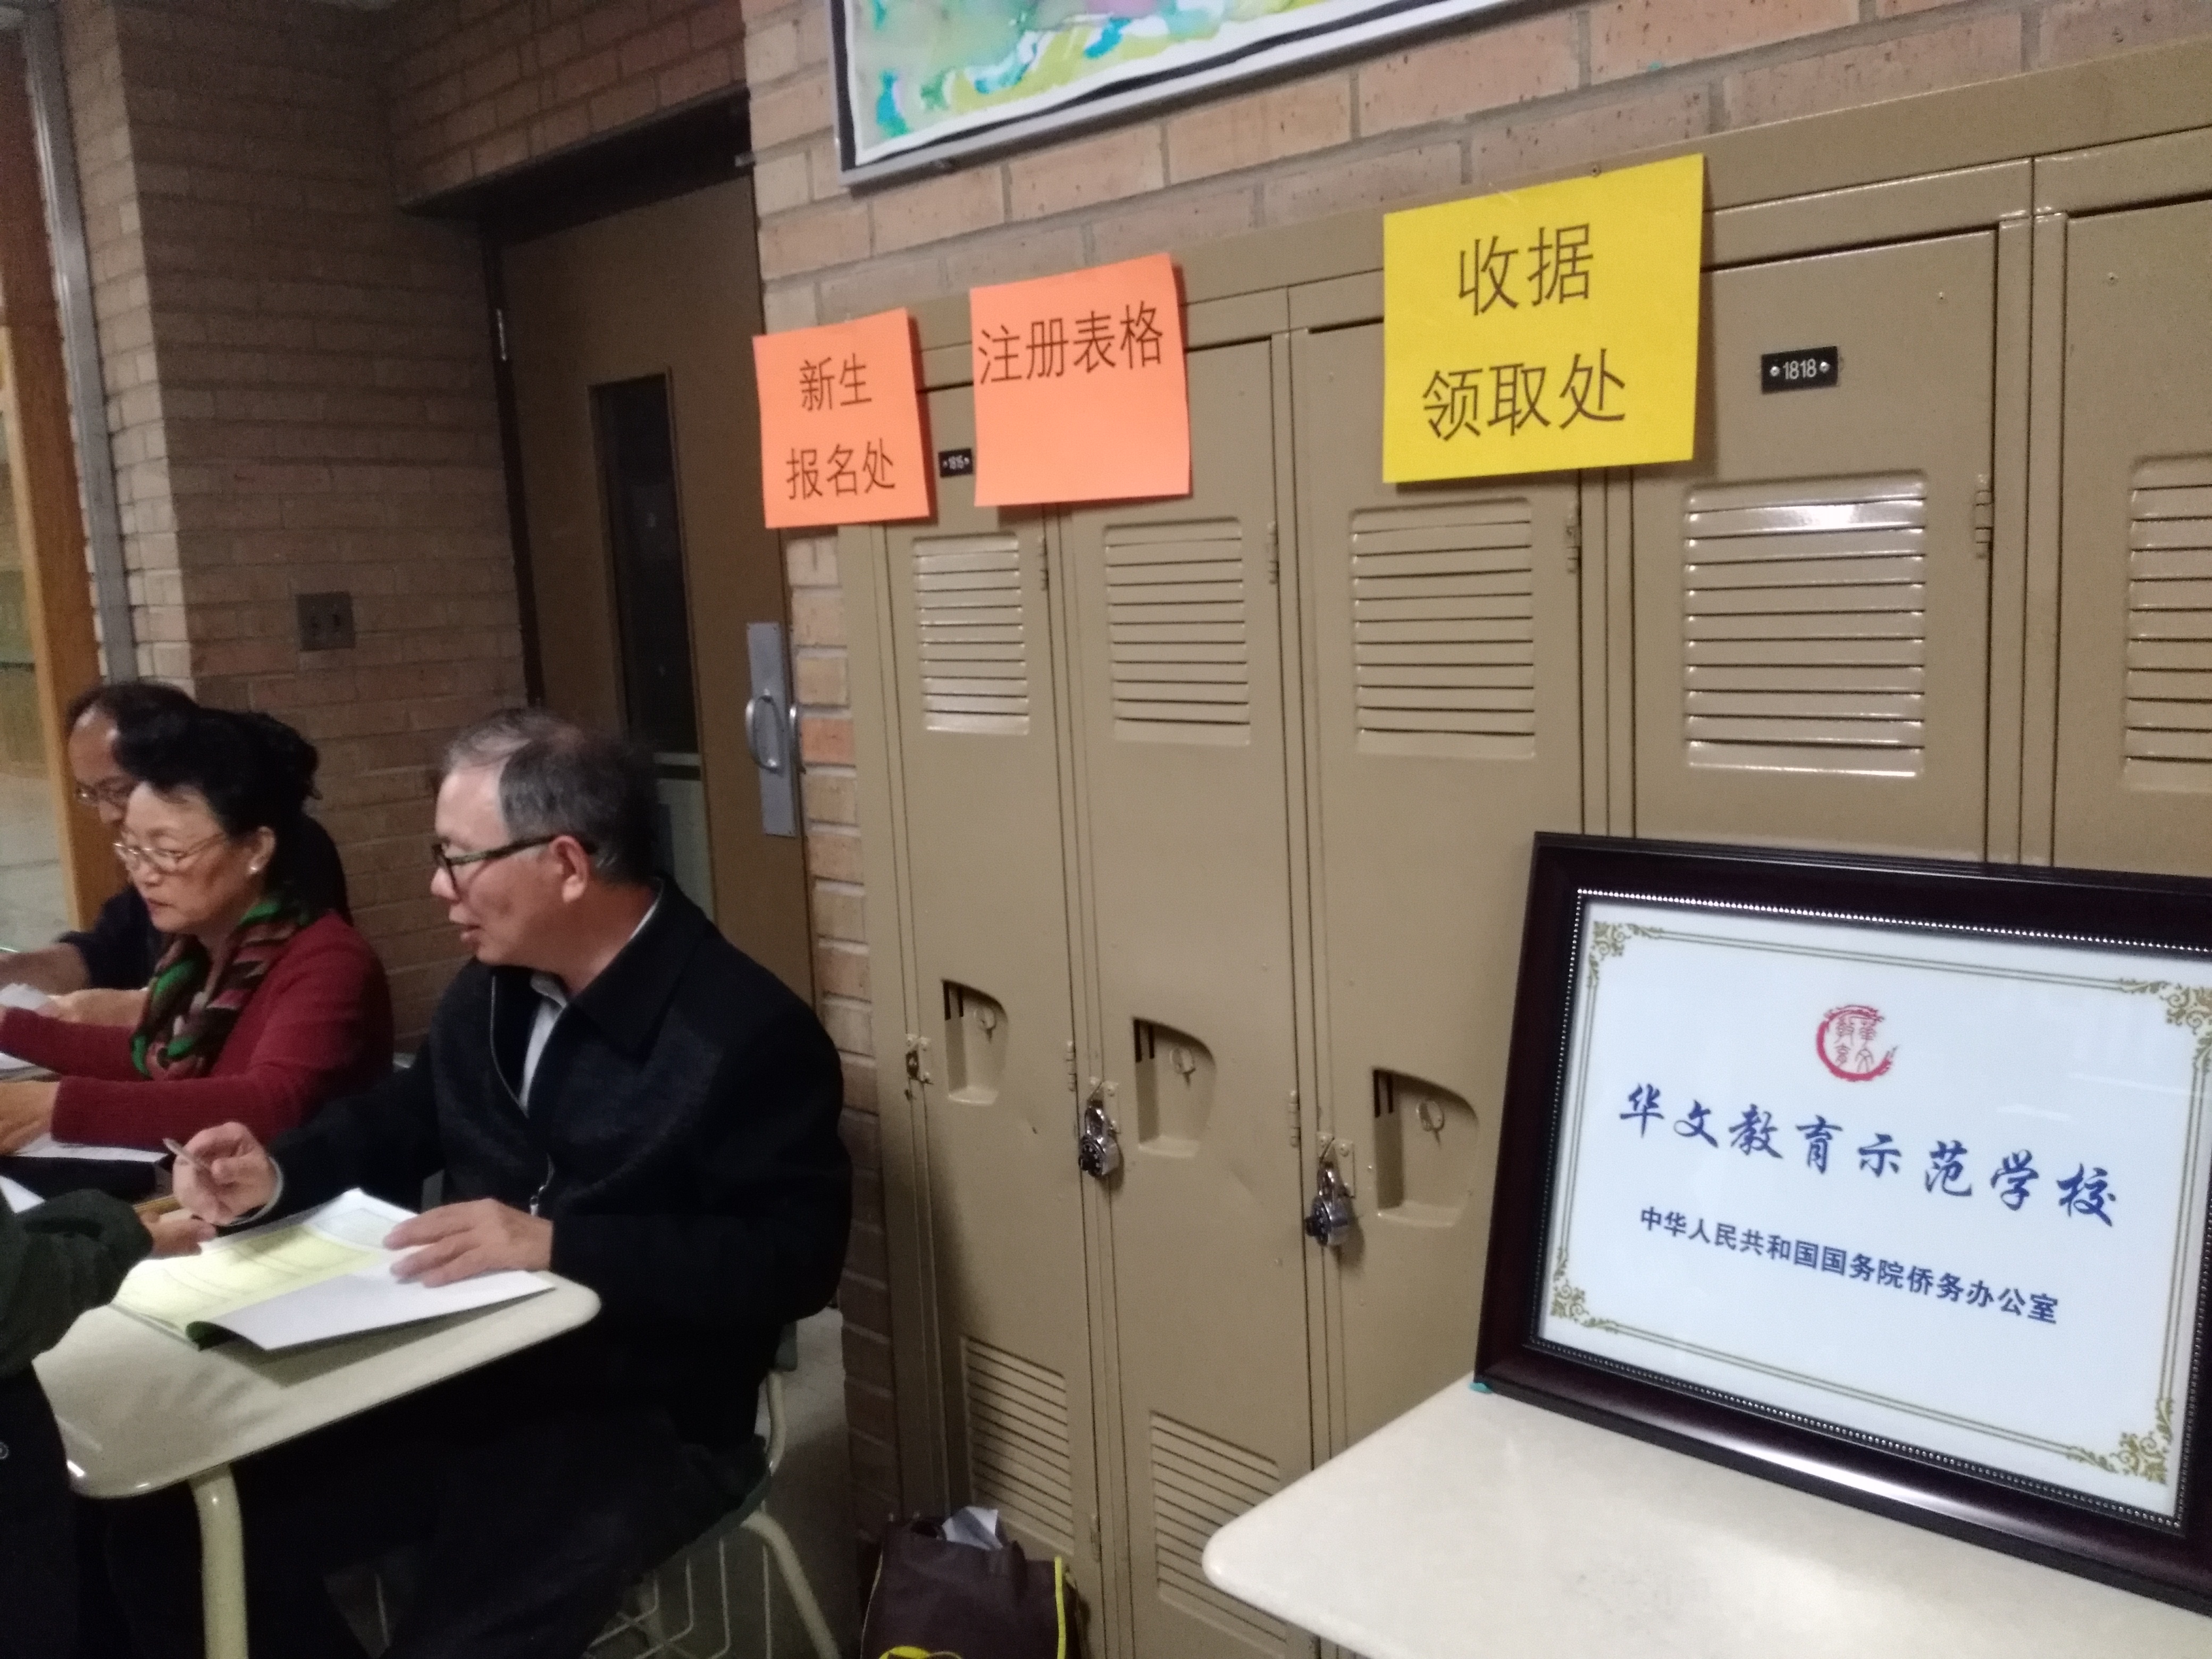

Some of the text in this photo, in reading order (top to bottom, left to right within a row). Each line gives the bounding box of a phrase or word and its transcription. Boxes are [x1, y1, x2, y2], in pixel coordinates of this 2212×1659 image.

[1457, 222, 1594, 317] 收据
[799, 353, 873, 412] 新生
[977, 300, 1163, 384] 注册表格
[1782, 358, 1817, 380] 1818
[1422, 347, 1626, 442] 领取处
[786, 439, 896, 500] 报名处
[1619, 1083, 2117, 1227] 华文教育示范学校
[1640, 1205, 2058, 1325] 中华人民共和国国务院侨务办公室
